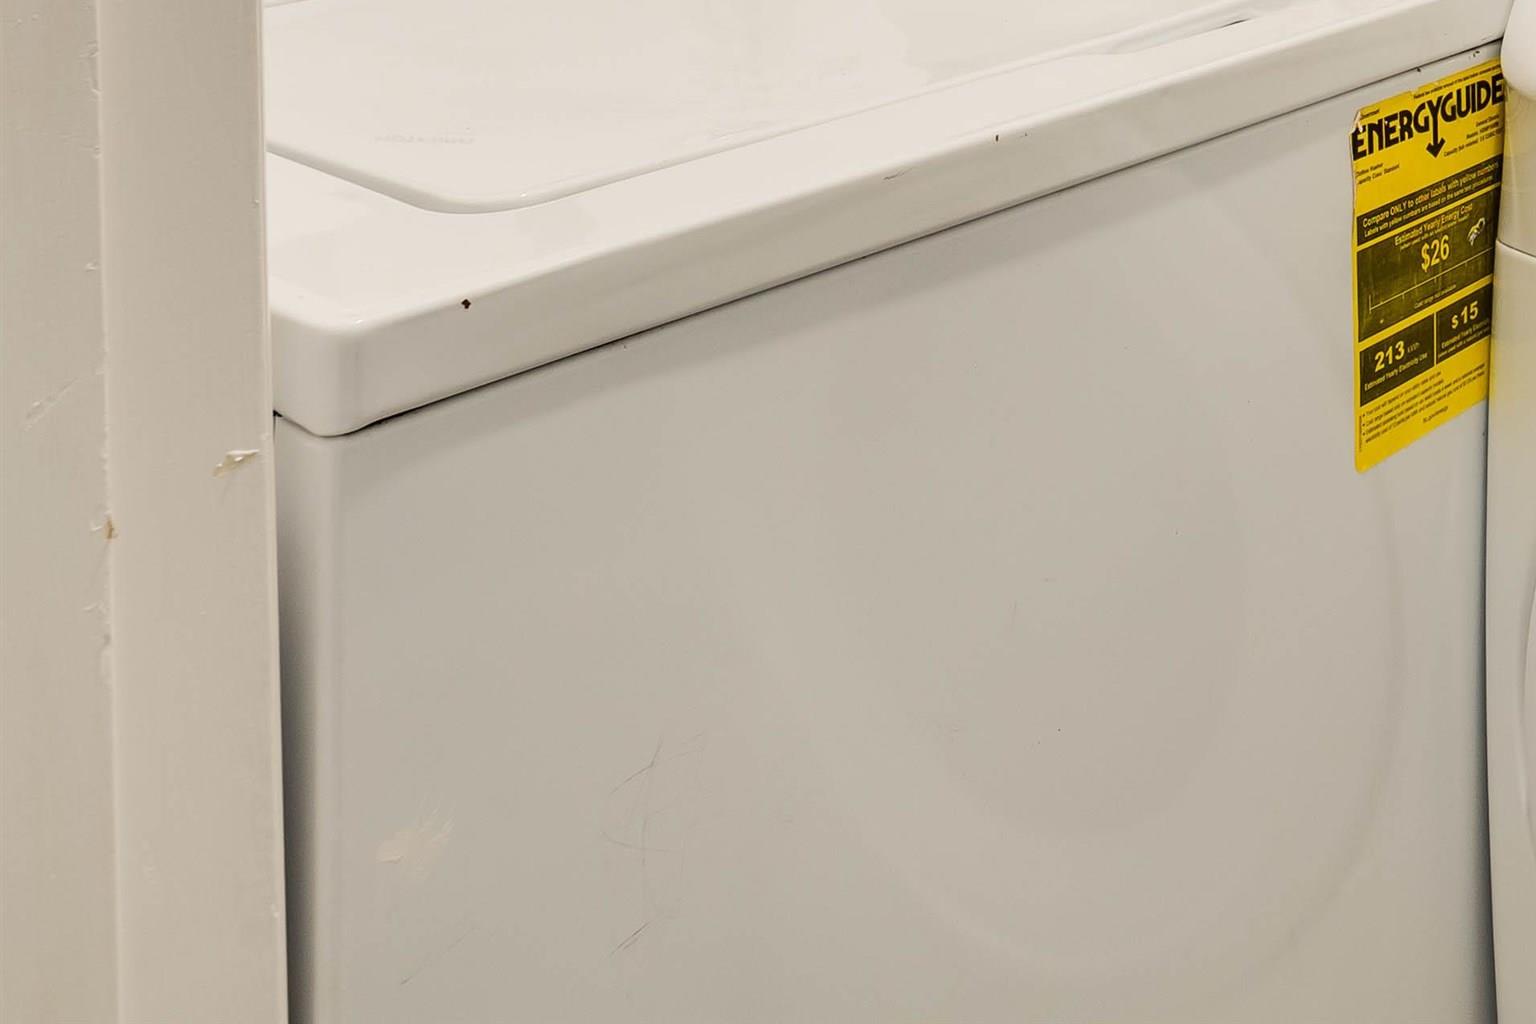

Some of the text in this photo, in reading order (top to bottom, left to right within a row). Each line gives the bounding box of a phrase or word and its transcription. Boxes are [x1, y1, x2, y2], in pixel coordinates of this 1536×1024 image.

[1352, 73, 1504, 161] ENERGYGUIDE
[1390, 201, 1408, 216] ONLY
[1421, 234, 1450, 272] $26
[1375, 340, 1405, 372] 213
